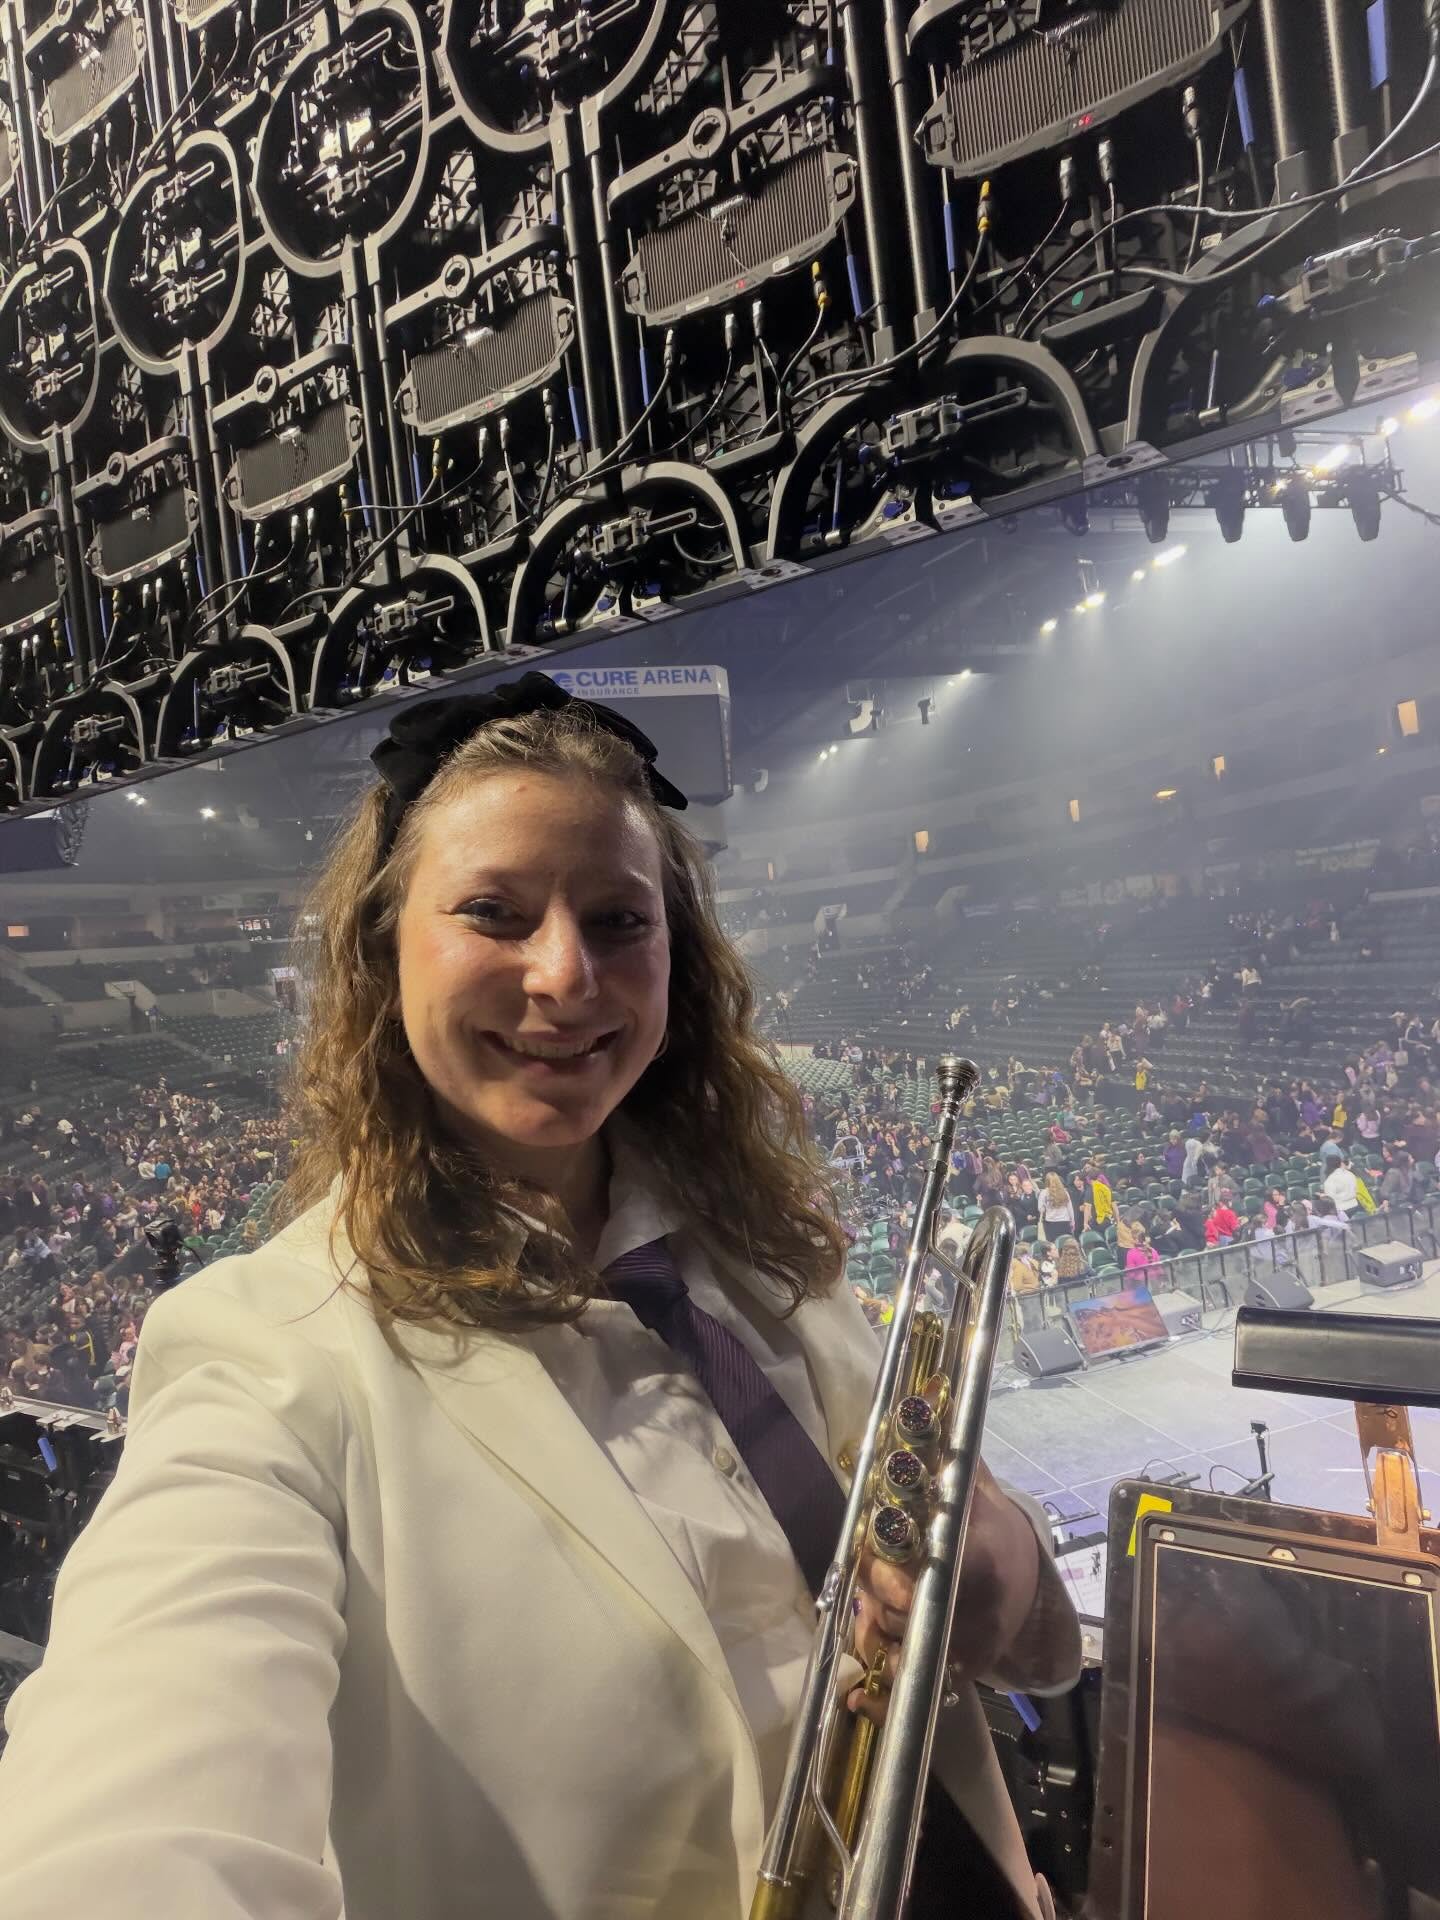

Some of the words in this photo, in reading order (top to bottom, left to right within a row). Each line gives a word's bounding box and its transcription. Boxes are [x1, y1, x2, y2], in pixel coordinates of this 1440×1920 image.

[576, 671, 638, 686] CURE
[643, 669, 712, 684] ARENA
[577, 688, 640, 696] INSURANCE
